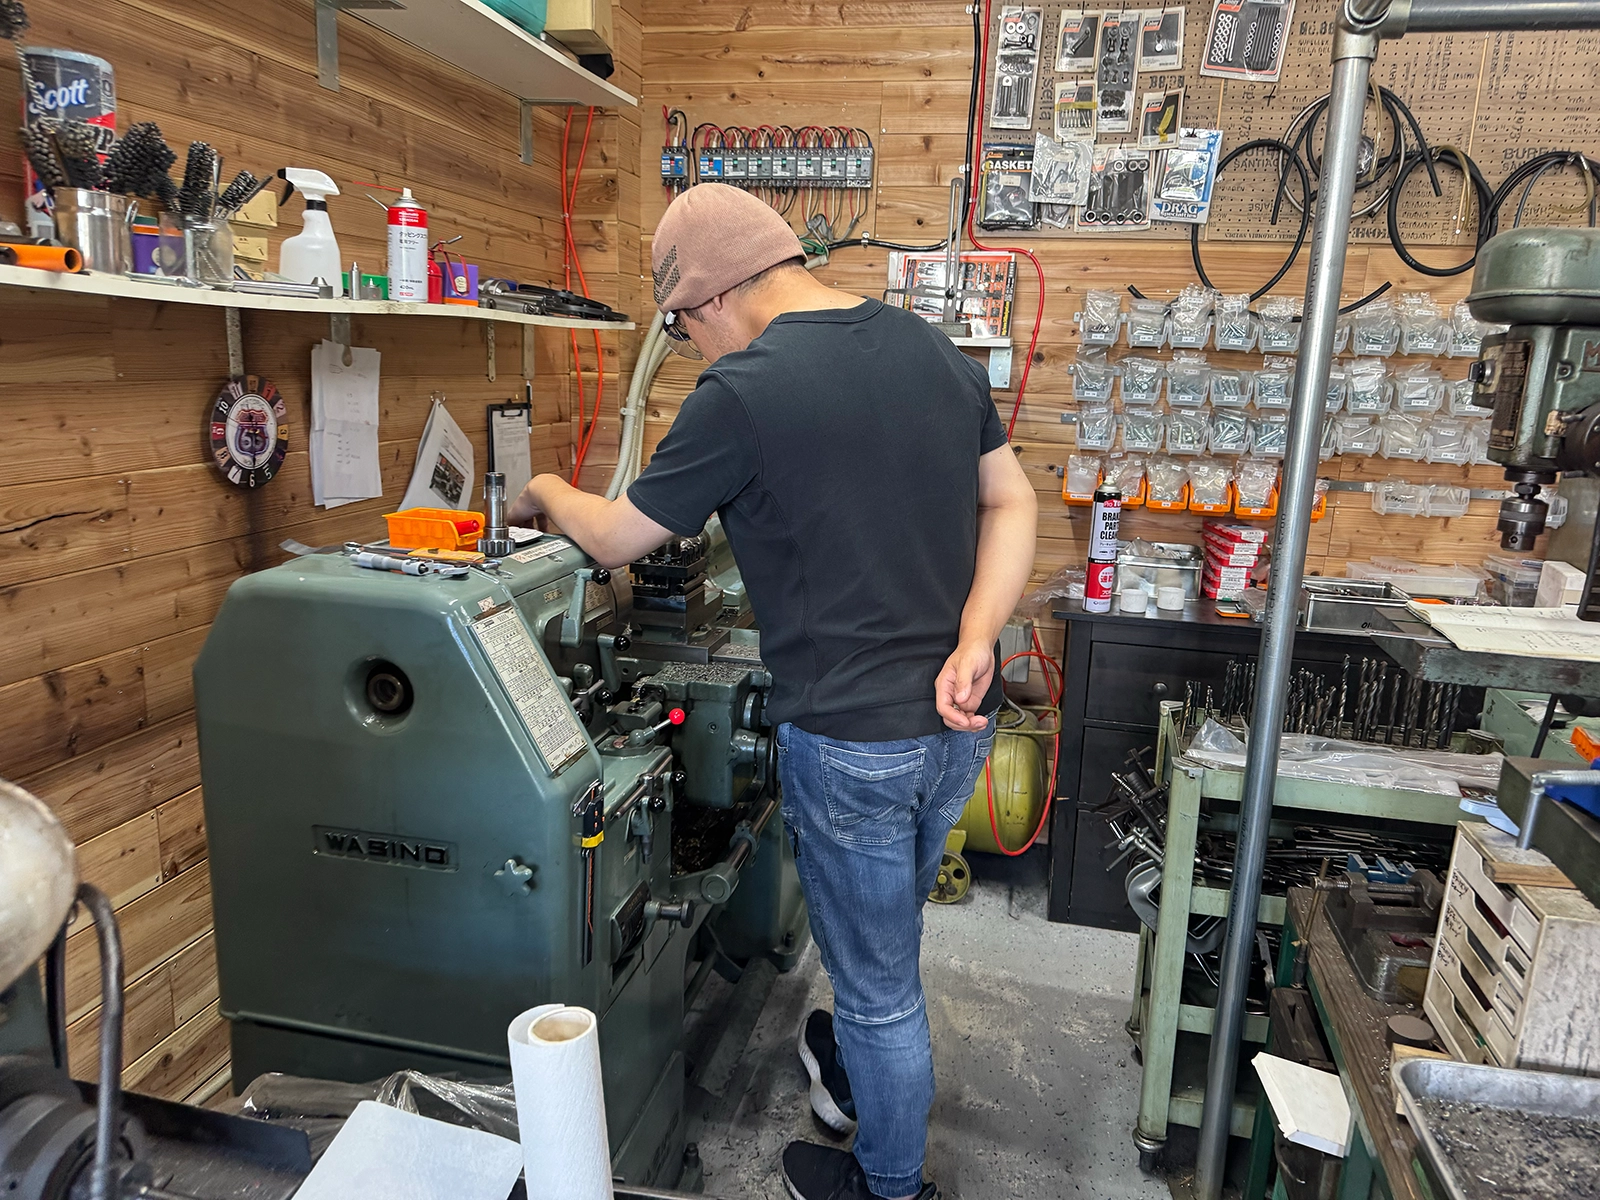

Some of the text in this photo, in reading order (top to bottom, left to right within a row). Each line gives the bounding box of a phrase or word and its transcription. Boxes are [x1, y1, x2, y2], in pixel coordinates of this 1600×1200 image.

[1243, 82, 1256, 104] ep.
[1161, 202, 1198, 214] DRAG
[219, 401, 229, 414] 10
[249, 473, 255, 487] 6
[264, 469, 272, 480] 5
[1100, 530, 1117, 540] CLEA
